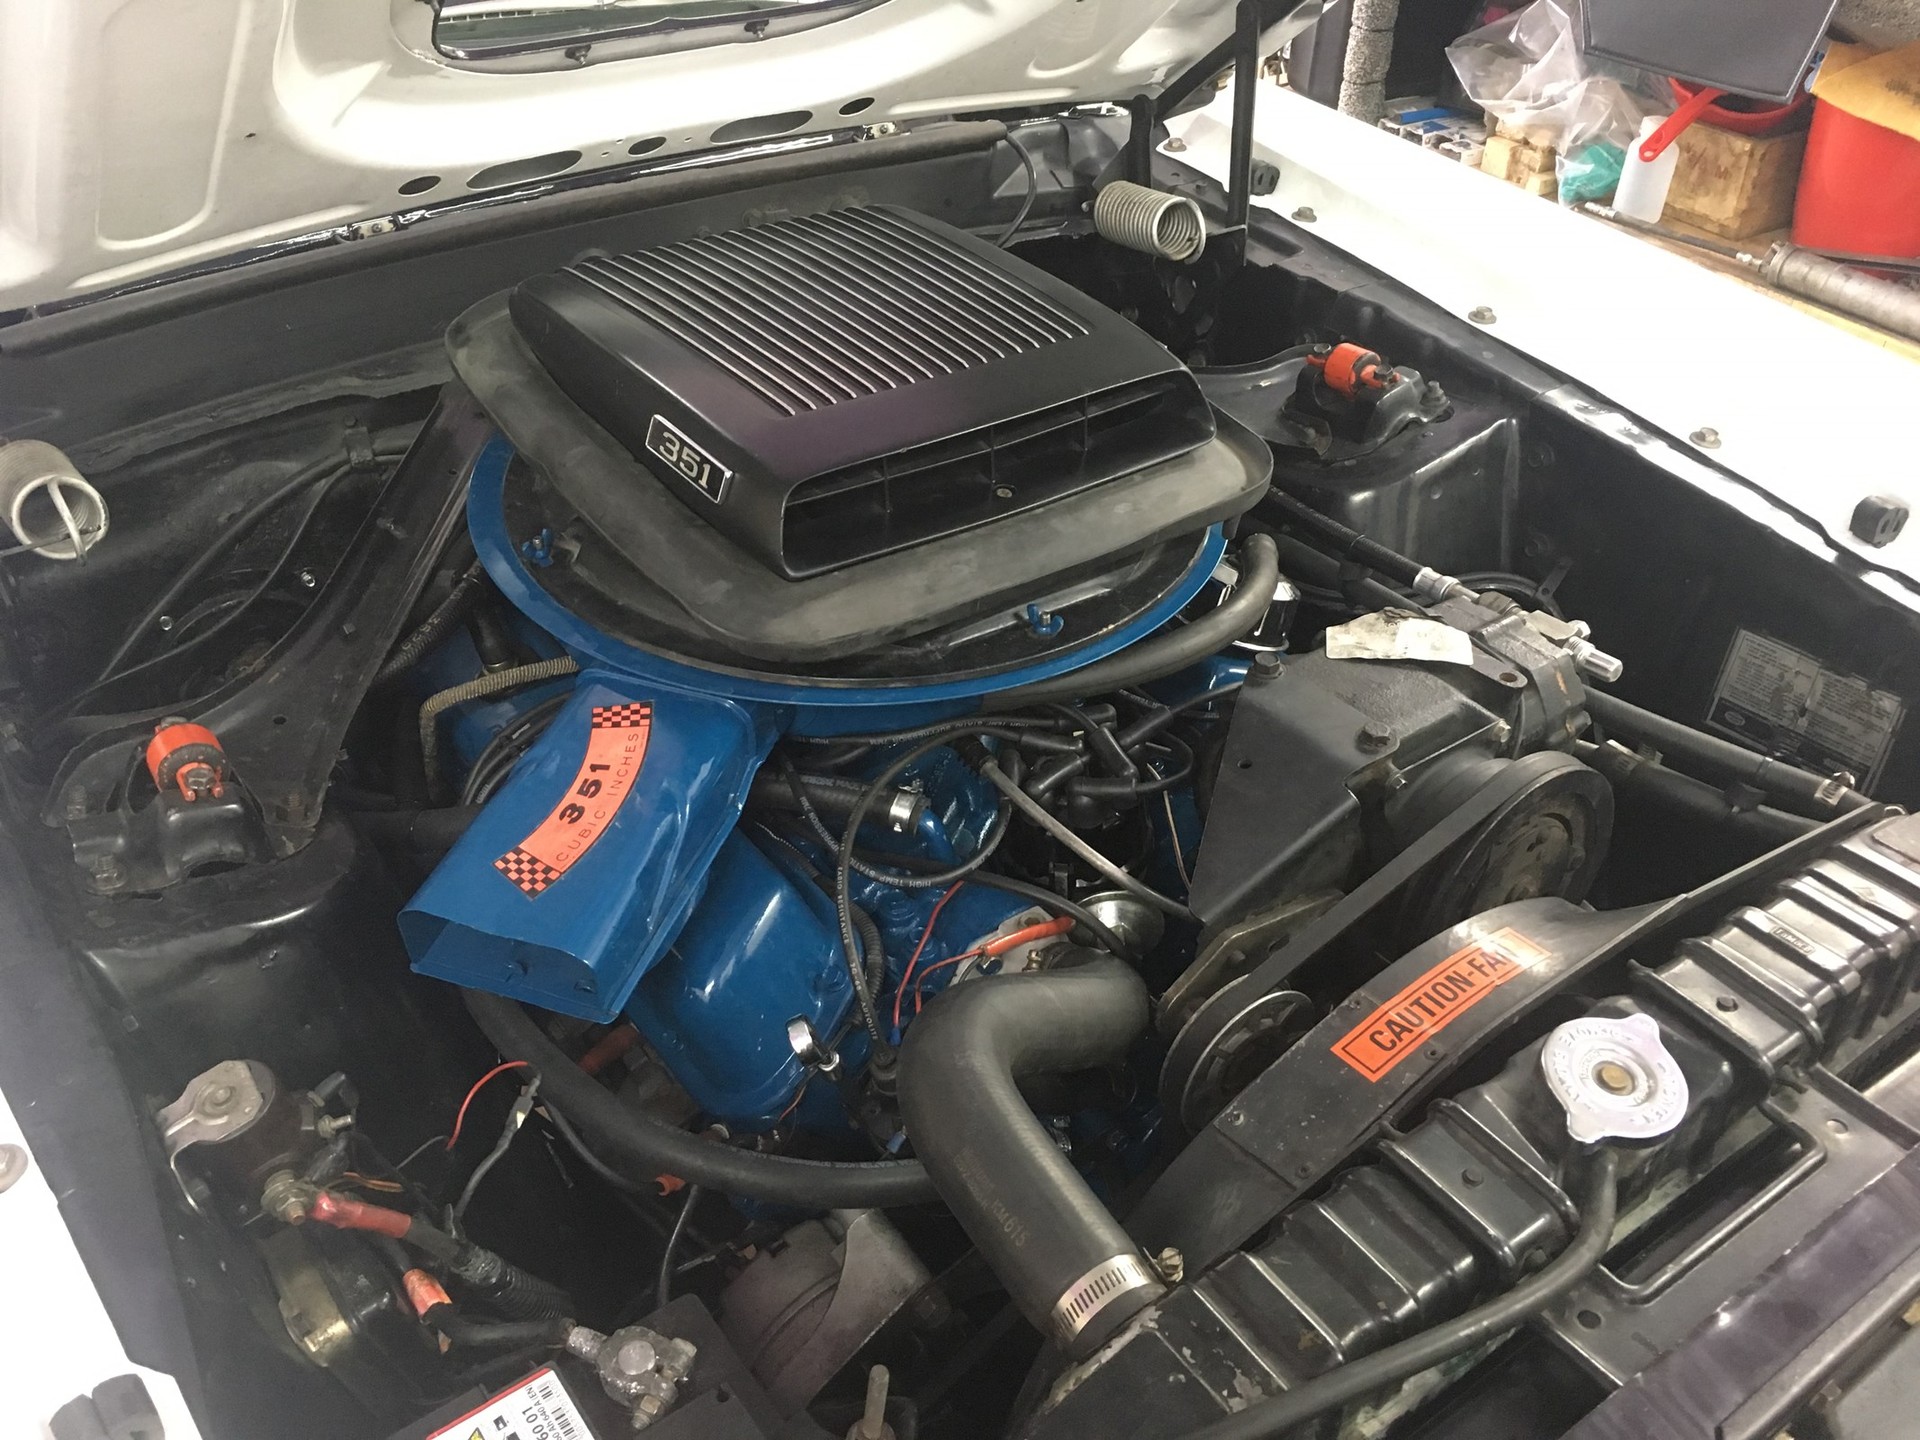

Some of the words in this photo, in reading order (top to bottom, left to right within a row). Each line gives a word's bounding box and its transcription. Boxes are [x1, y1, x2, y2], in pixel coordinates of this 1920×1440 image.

[660, 432, 711, 489] 351
[556, 810, 606, 862] CUBIC
[606, 732, 640, 796] INCHES
[558, 763, 611, 825] 351
[879, 874, 905, 887] TEMP
[908, 880, 932, 888] HIGH
[860, 1001, 879, 1040] AUTOLITE
[522, 1407, 538, 1424] 01
[537, 1406, 550, 1421] 640
[547, 1421, 556, 1432] Ah
